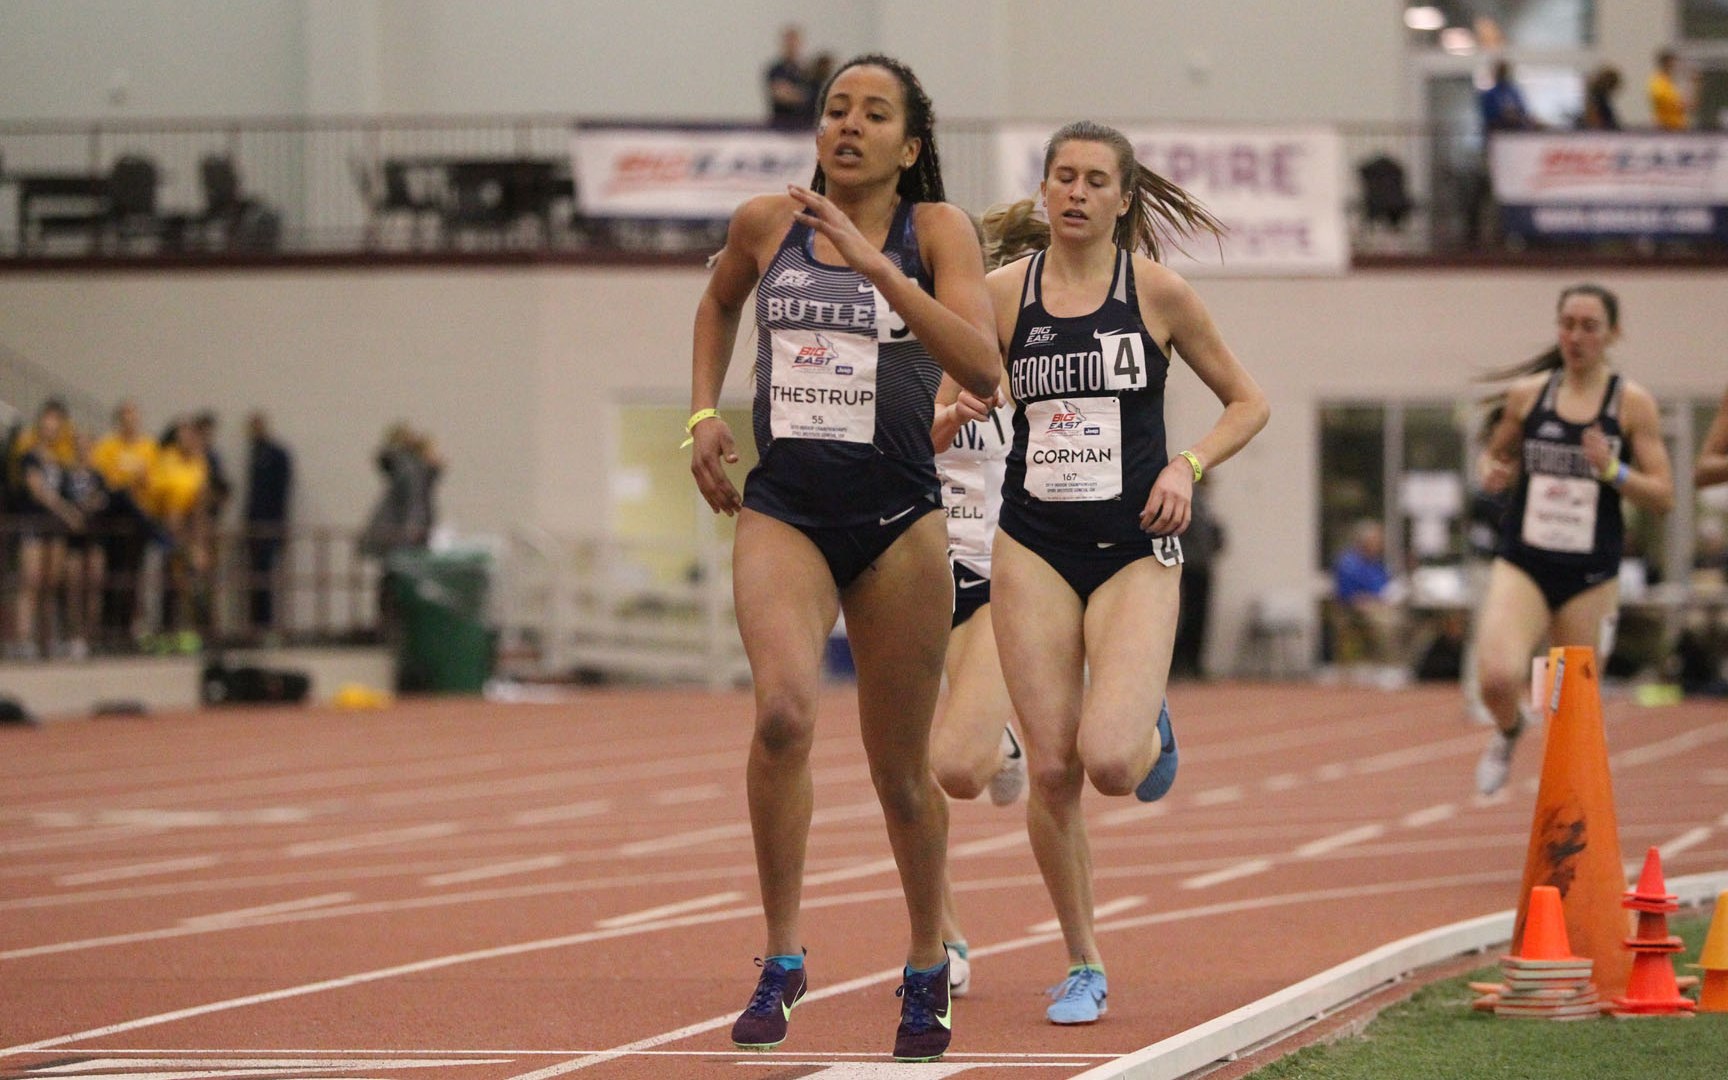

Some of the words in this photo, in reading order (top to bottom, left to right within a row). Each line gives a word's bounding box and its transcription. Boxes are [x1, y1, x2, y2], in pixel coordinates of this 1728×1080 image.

[768, 298, 873, 328] BUTLE
[1030, 326, 1052, 335] BIG
[1026, 333, 1058, 343] EAST
[799, 346, 827, 356] BIG
[794, 356, 832, 366] EAST
[1114, 337, 1140, 385] 4
[1011, 351, 1102, 400] GEORGETO
[772, 386, 873, 406] THESTRUP
[812, 416, 824, 425] 55
[1052, 413, 1076, 422] BIG
[1048, 422, 1082, 430] EAST
[1033, 448, 1112, 465] CORMAN
[1063, 472, 1077, 481] 167
